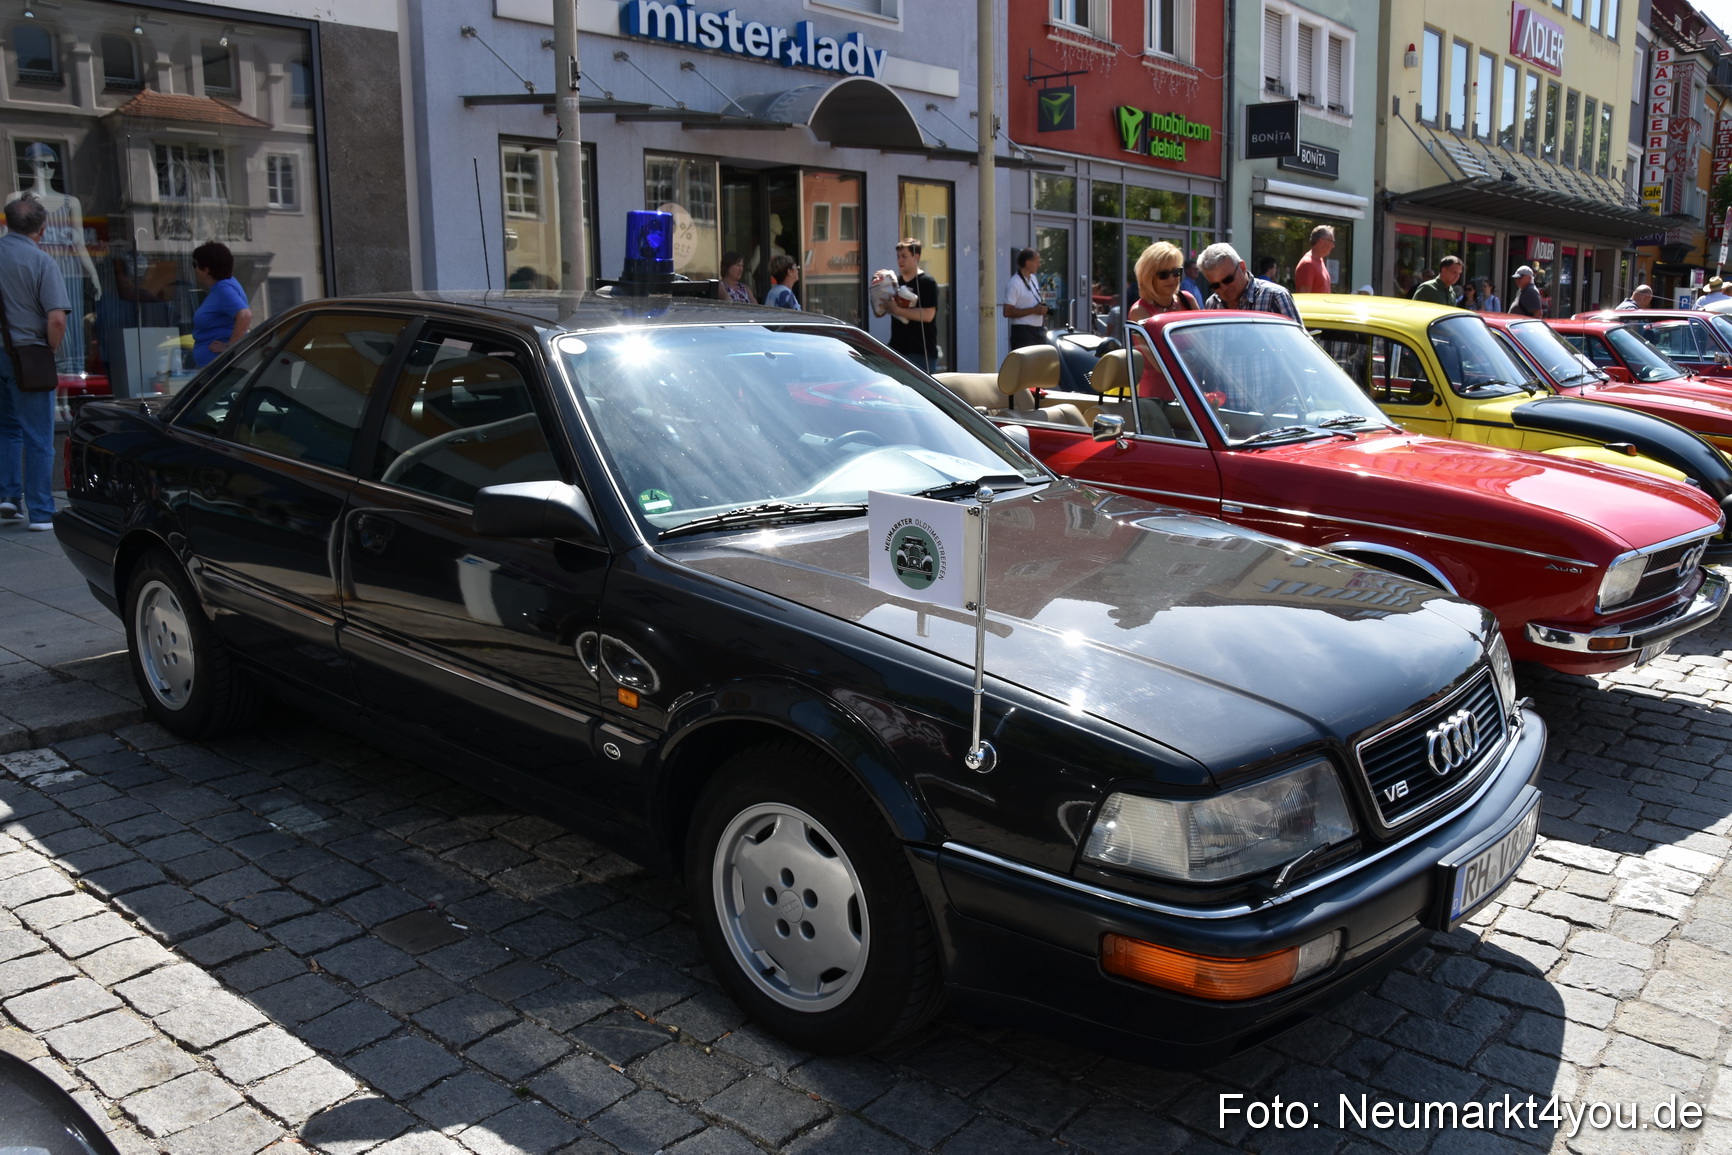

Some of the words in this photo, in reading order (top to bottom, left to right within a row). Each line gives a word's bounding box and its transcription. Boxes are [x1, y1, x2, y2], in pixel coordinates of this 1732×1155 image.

[638, 0, 787, 59] mister
[806, 20, 888, 79] lady
[1522, 9, 1564, 70] ADLER
[1152, 111, 1211, 142] mobilcom
[1649, 49, 1670, 182] BÄCKEREI
[1151, 136, 1187, 162] debitel
[1533, 237, 1555, 260] ADLER
[1681, 297, 1689, 308] P
[650, 489, 660, 501] 4
[884, 517, 913, 552] NEUMARKTER
[914, 518, 947, 581] OLDTIMERTREFFEN
[1383, 780, 1409, 802] V8
[1462, 852, 1491, 907] RH
